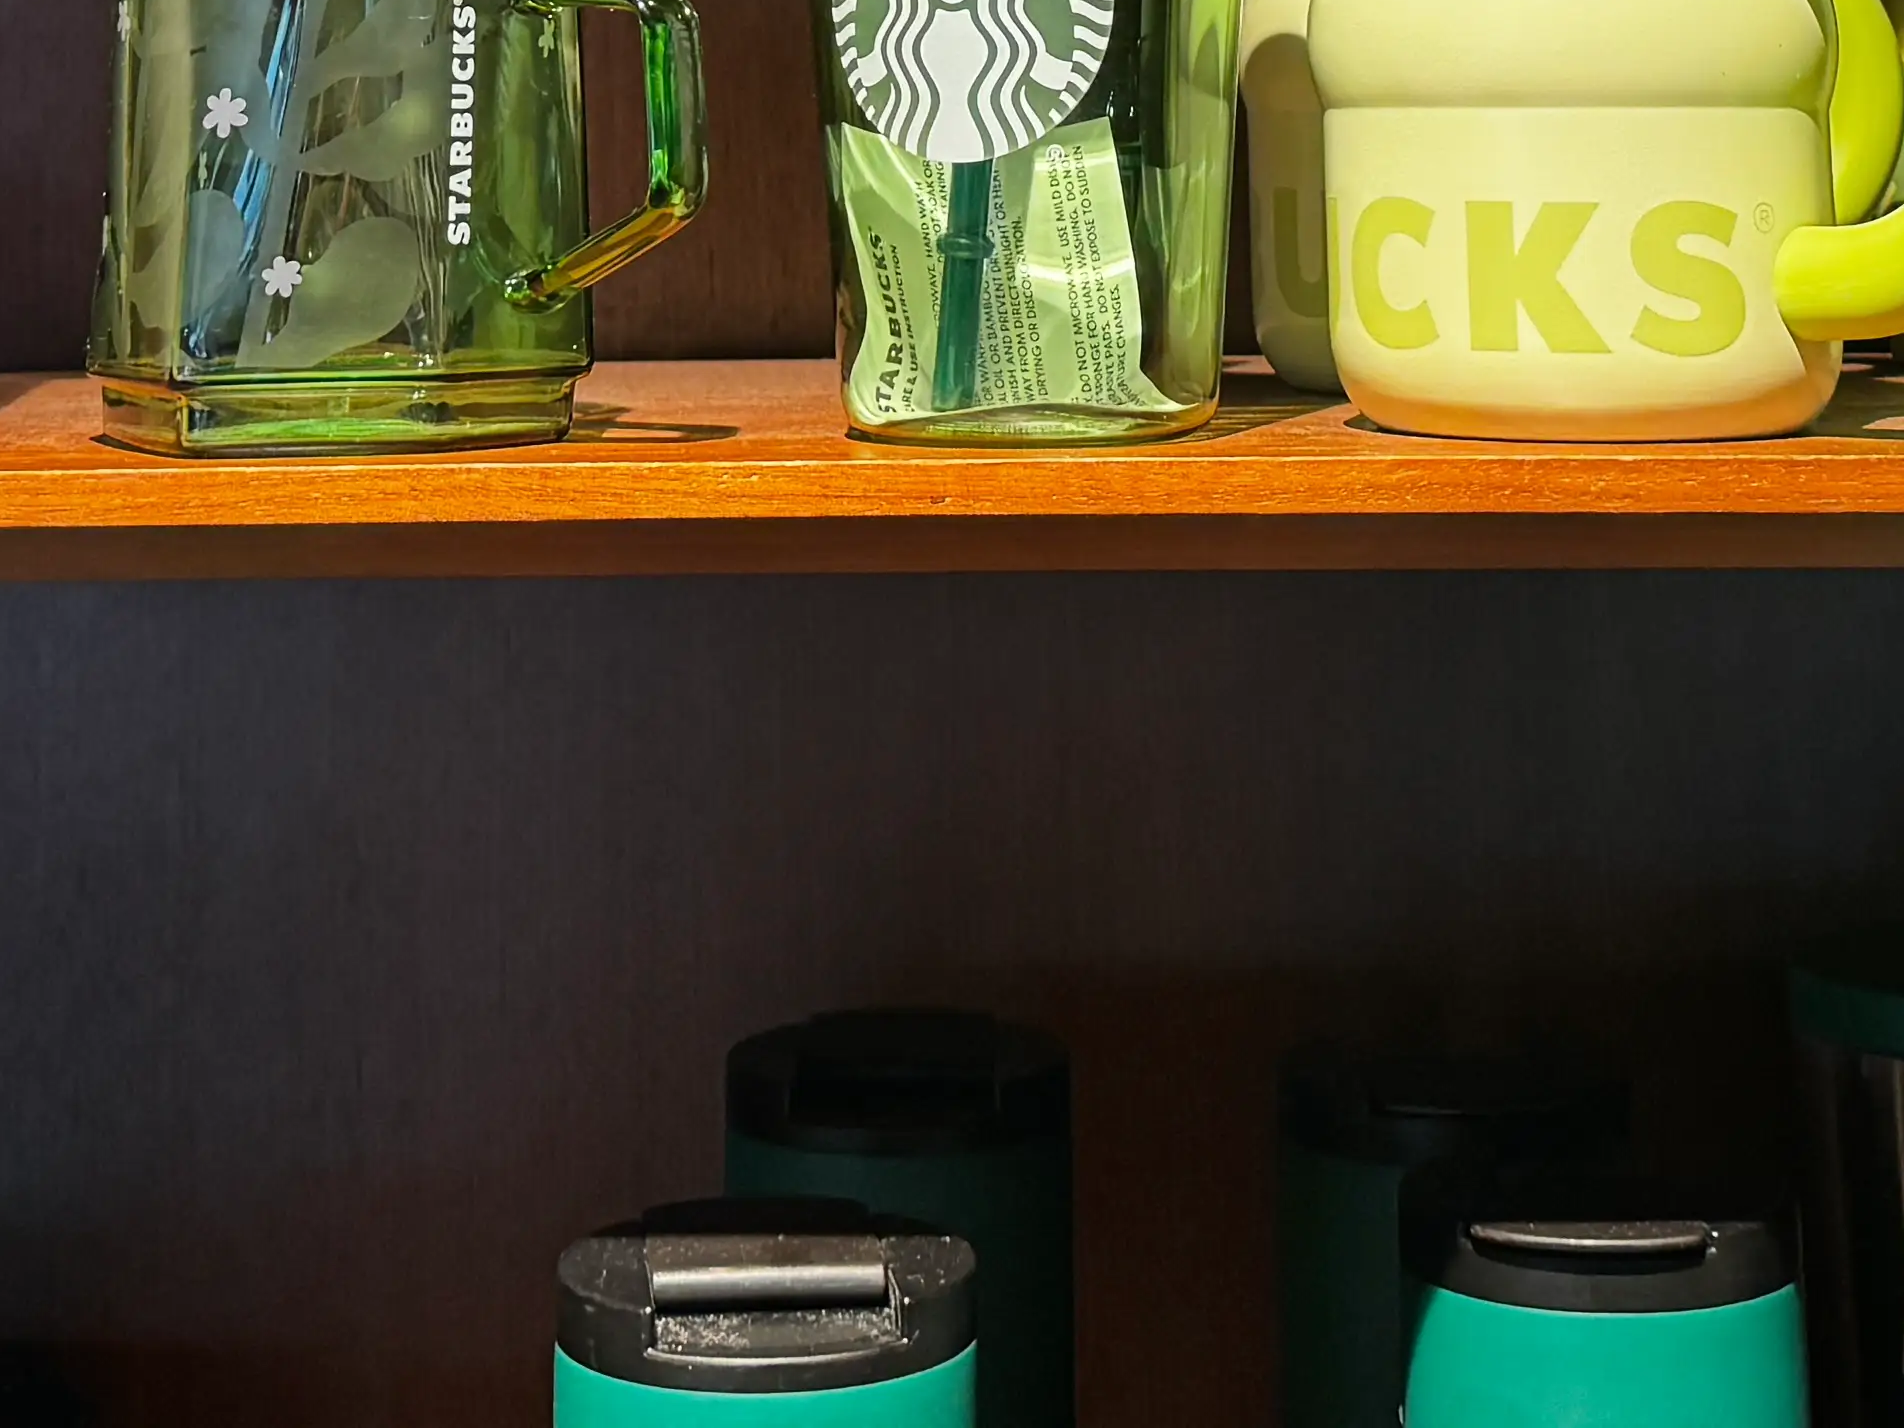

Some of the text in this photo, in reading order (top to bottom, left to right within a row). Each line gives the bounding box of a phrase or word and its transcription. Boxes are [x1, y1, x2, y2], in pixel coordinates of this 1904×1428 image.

[1073, 145, 1089, 194] SUDDEN
[1066, 181, 1077, 200] DO
[995, 201, 1006, 219] OR
[1053, 190, 1066, 221] MILD
[1080, 198, 1092, 214] TO
[922, 223, 934, 258] HAND
[1058, 226, 1070, 247] USE
[1087, 218, 1100, 262] EXPOSE
[999, 224, 1016, 282] SUNLIGHT
[1009, 284, 1023, 329] DIRECT
[1097, 294, 1108, 313] DO
[1028, 323, 1040, 341] OR
[1087, 312, 1099, 338] FOR
[909, 343, 919, 372] USE
[991, 344, 1002, 363] OR
[1004, 336, 1015, 365] AND
[1017, 333, 1029, 373] FROM
[1075, 340, 1087, 369] NOT
[1032, 346, 1048, 395] DRYING
[1081, 373, 1092, 392] DO
